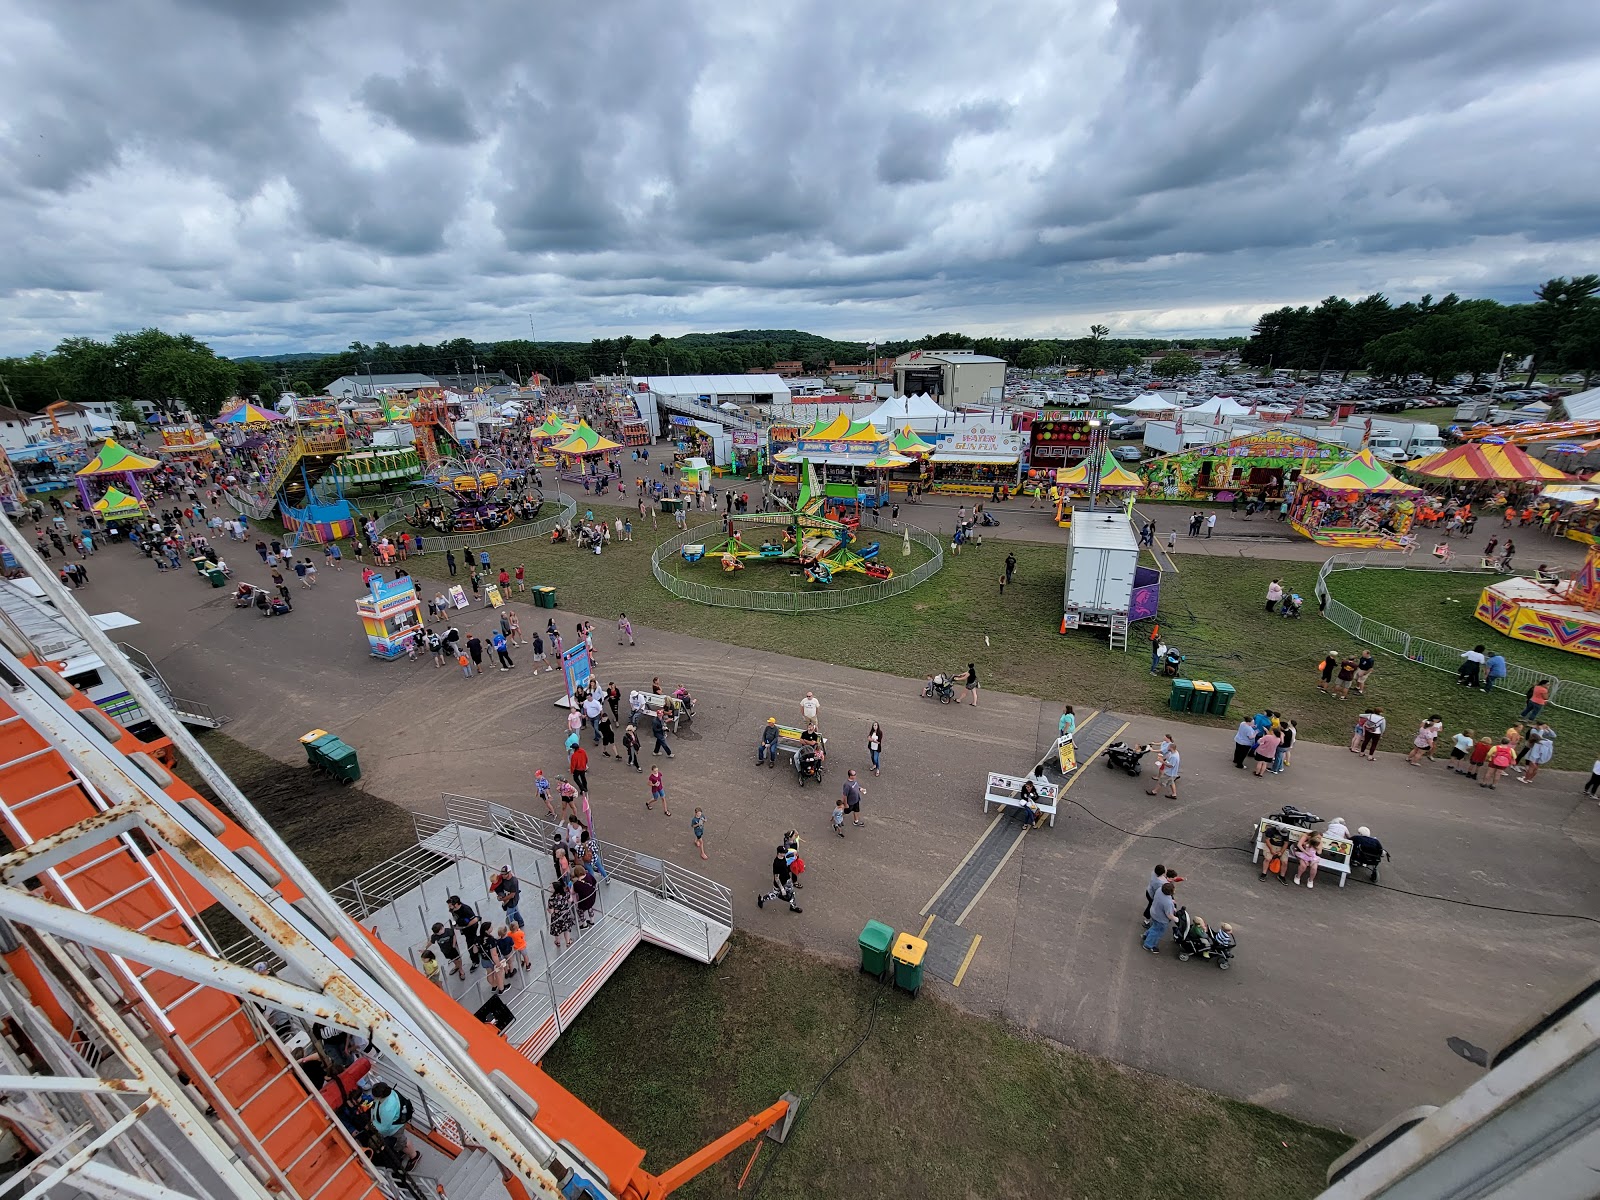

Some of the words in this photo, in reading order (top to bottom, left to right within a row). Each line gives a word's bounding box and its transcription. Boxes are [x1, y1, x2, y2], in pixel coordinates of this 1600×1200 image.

[1035, 411, 1061, 420] BIG
[955, 442, 976, 450] GUN
[1230, 436, 1317, 449] MADAGASCAR
